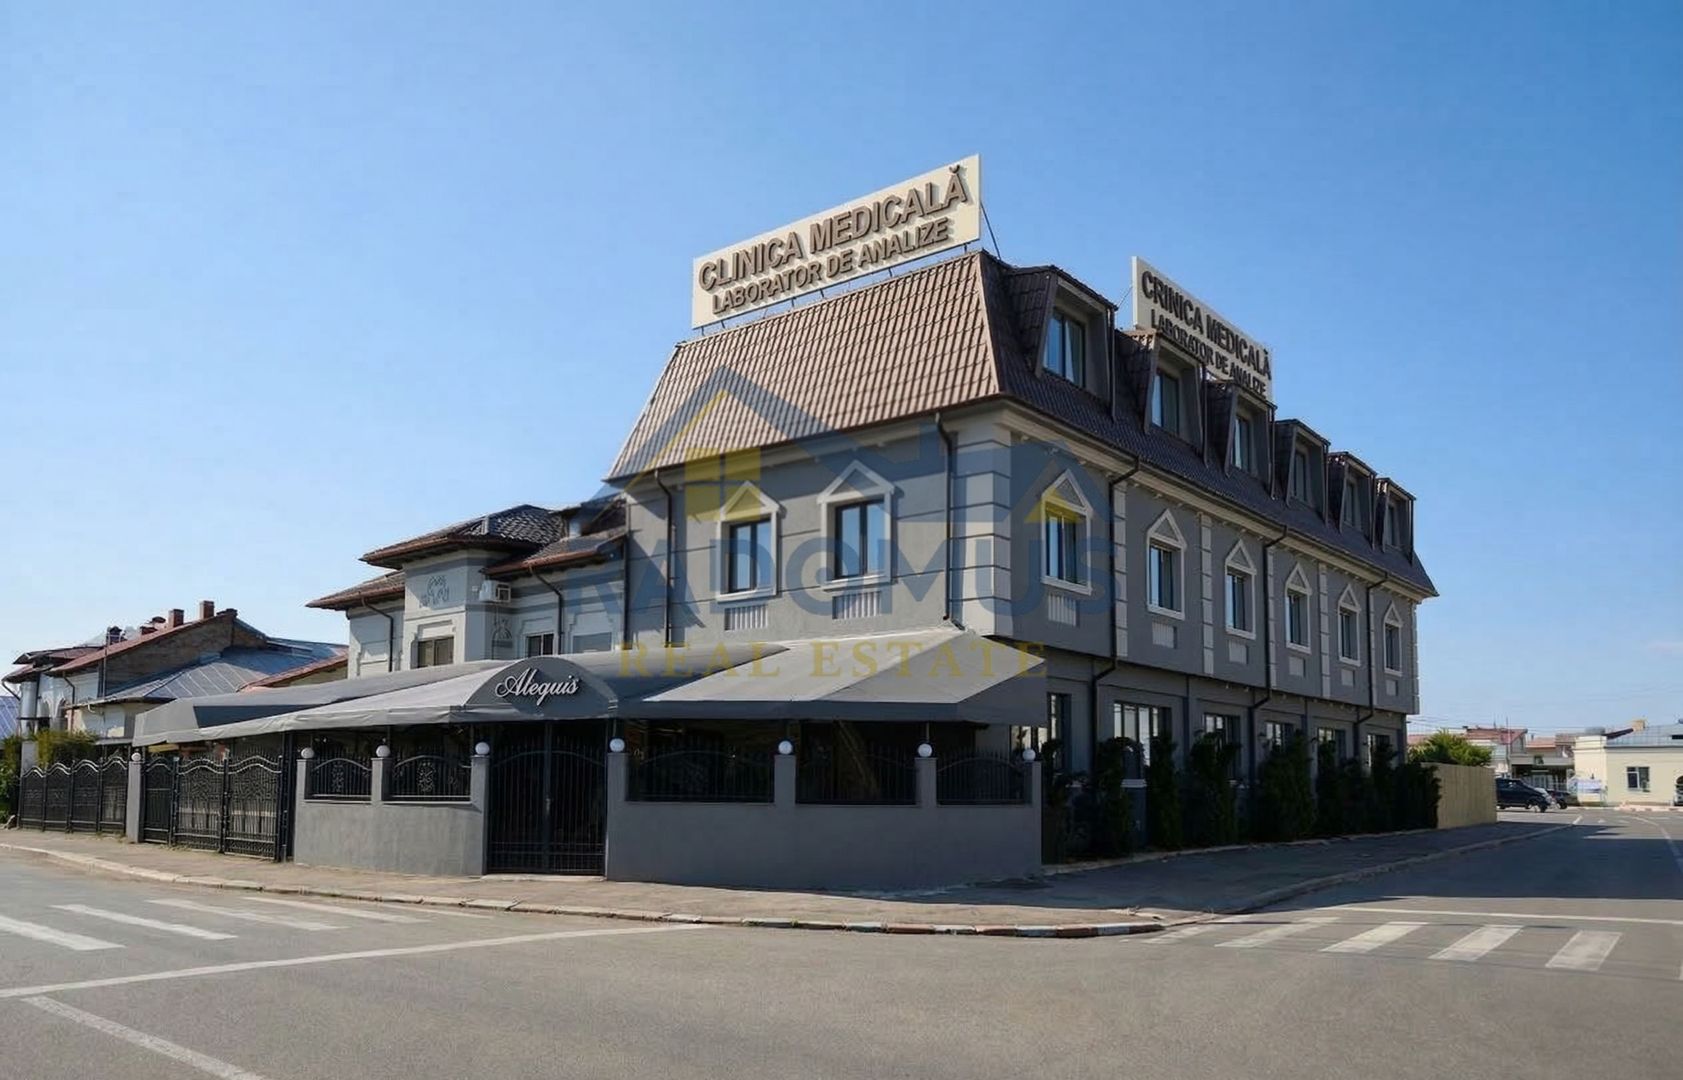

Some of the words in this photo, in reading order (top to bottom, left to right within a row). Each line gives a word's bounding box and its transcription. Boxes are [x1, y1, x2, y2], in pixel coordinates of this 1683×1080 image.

[699, 231, 804, 291] CLINICA
[809, 164, 968, 254] MEDICALĂ
[712, 262, 822, 315] LABORATOR
[826, 249, 854, 279] DE
[858, 217, 949, 268] ANALIZE
[1142, 271, 1204, 335] CRINICA
[1151, 309, 1214, 366] LABORATOR
[1216, 352, 1229, 375] DE
